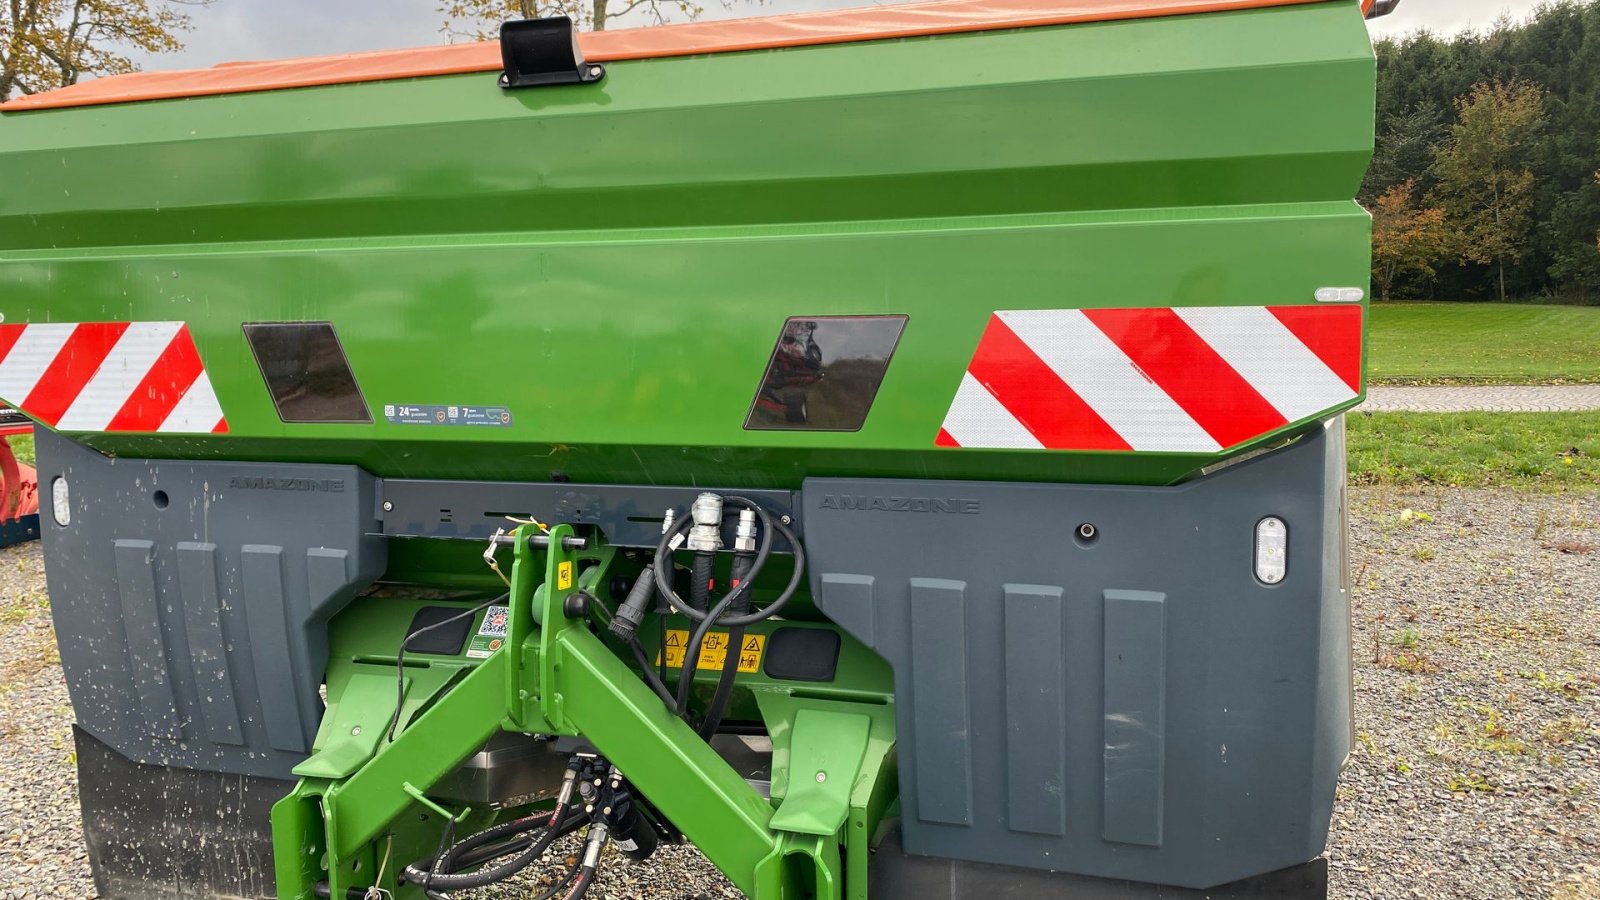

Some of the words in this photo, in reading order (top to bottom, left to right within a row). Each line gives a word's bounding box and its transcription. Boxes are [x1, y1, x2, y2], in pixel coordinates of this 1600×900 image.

[398, 406, 410, 417] 24
[462, 407, 469, 418] 7
[229, 476, 345, 493] AMAZONE
[818, 494, 980, 515] AMAZONE
